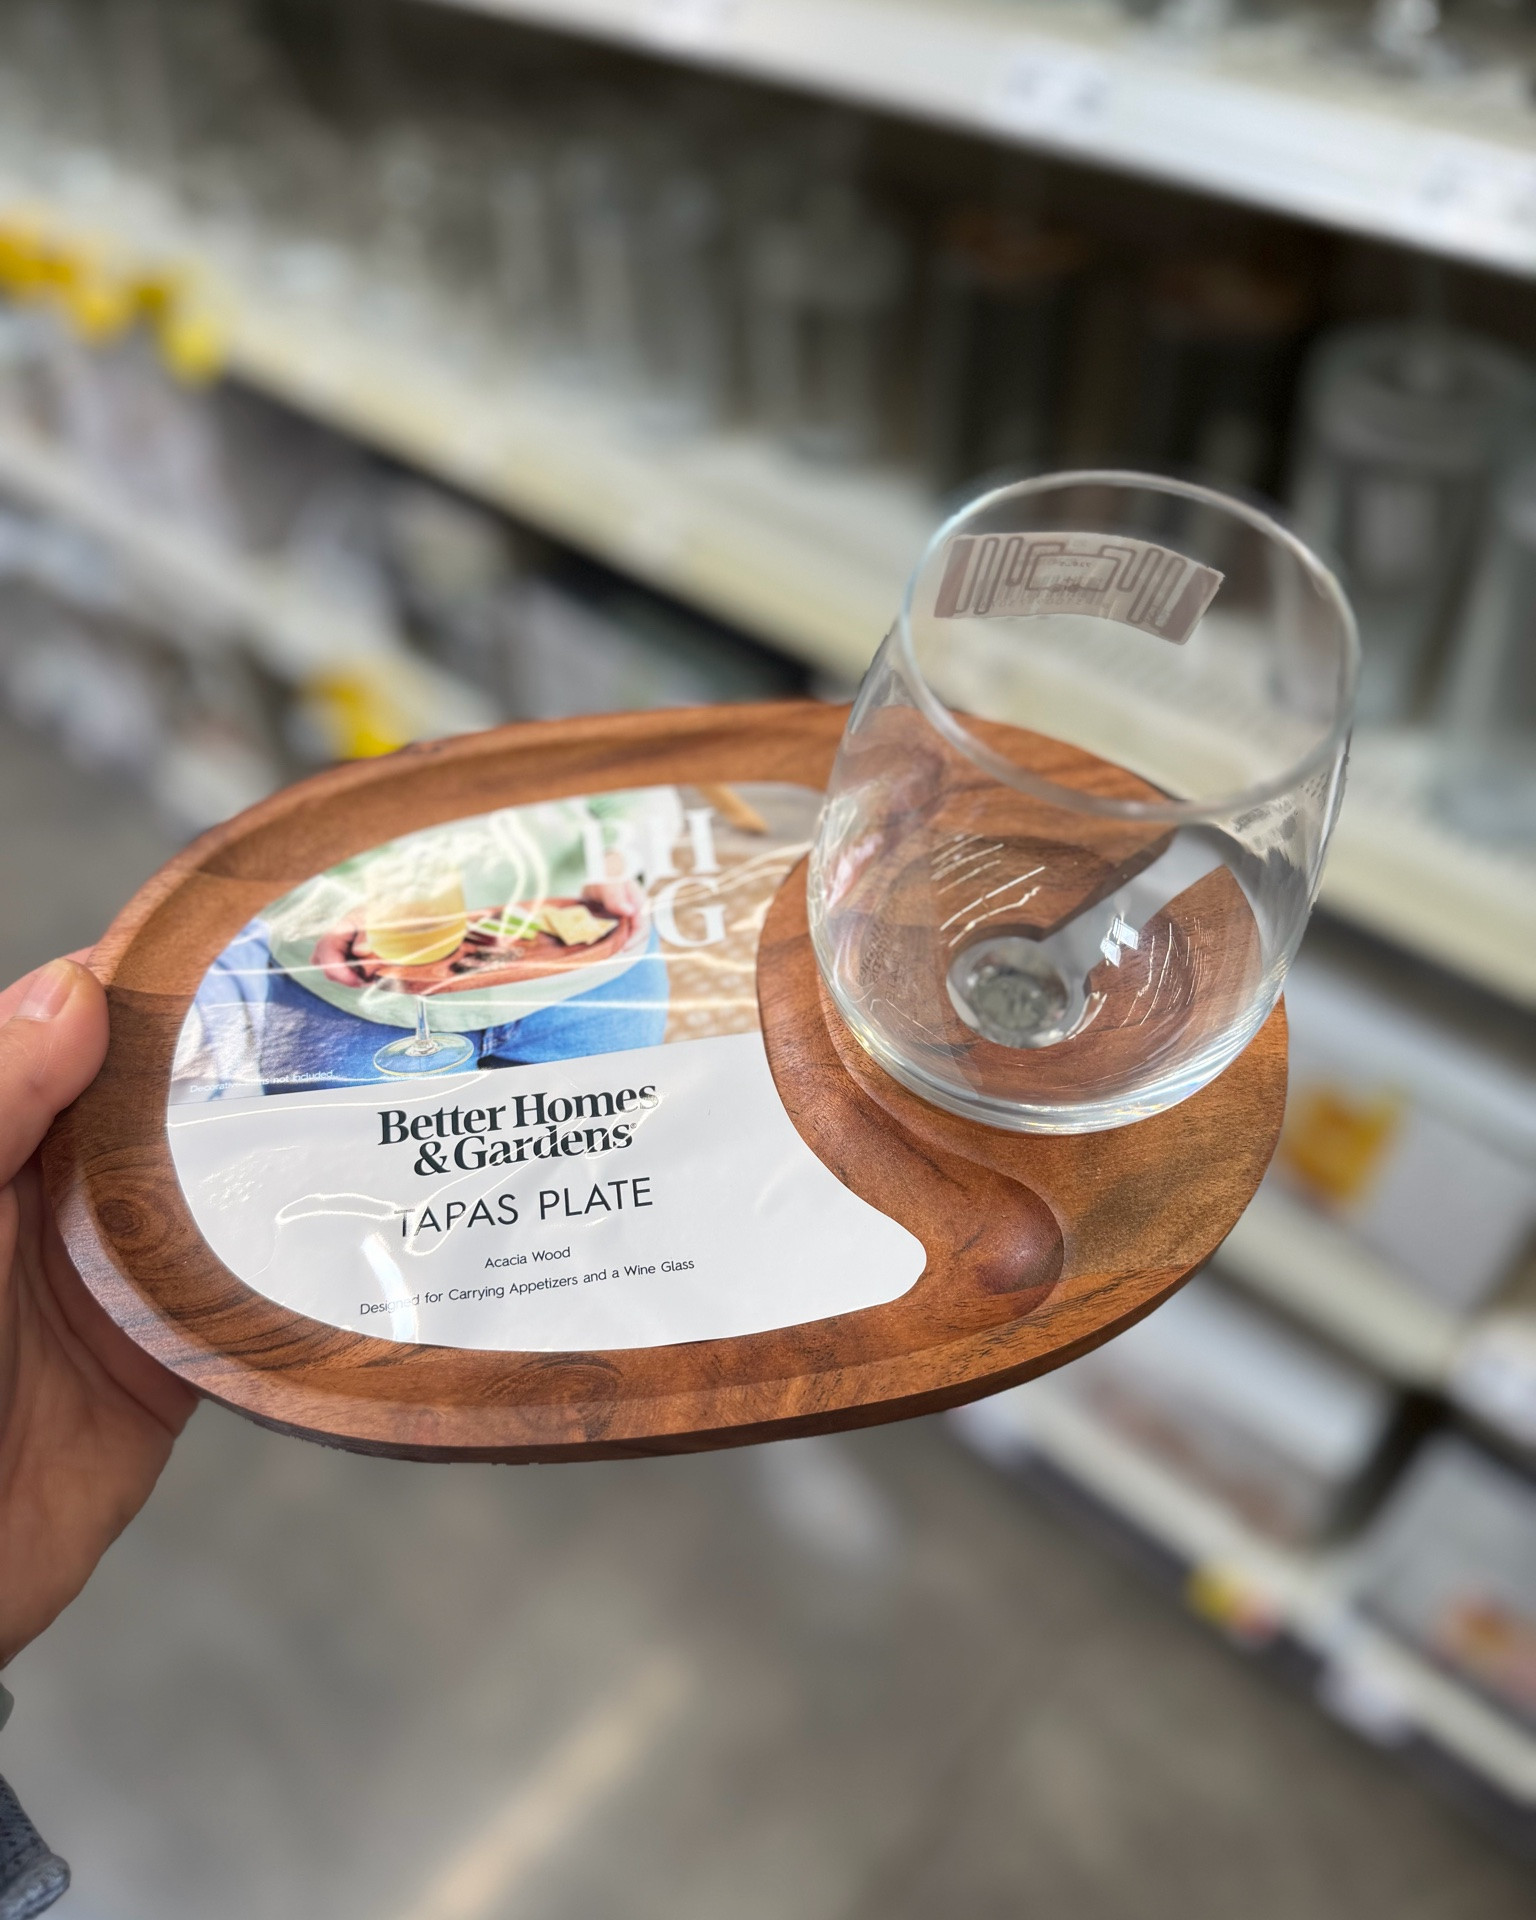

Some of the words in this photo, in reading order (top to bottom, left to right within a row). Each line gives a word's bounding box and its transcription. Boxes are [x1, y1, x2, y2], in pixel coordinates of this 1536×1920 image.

[652, 876, 727, 948] G
[378, 1104, 506, 1146] Better
[512, 1084, 660, 1128] Homes
[394, 1193, 519, 1237] TAPAS
[539, 1176, 654, 1220] PLATE
[425, 1291, 443, 1304] for
[448, 1285, 505, 1303] Carrying
[509, 1273, 578, 1295] Appetizers
[583, 1268, 607, 1284] and
[611, 1270, 620, 1280] a
[624, 1264, 656, 1277] Wine
[660, 1257, 695, 1273] Glass
[484, 1253, 527, 1269] Acacia
[531, 1246, 571, 1263] Wood
